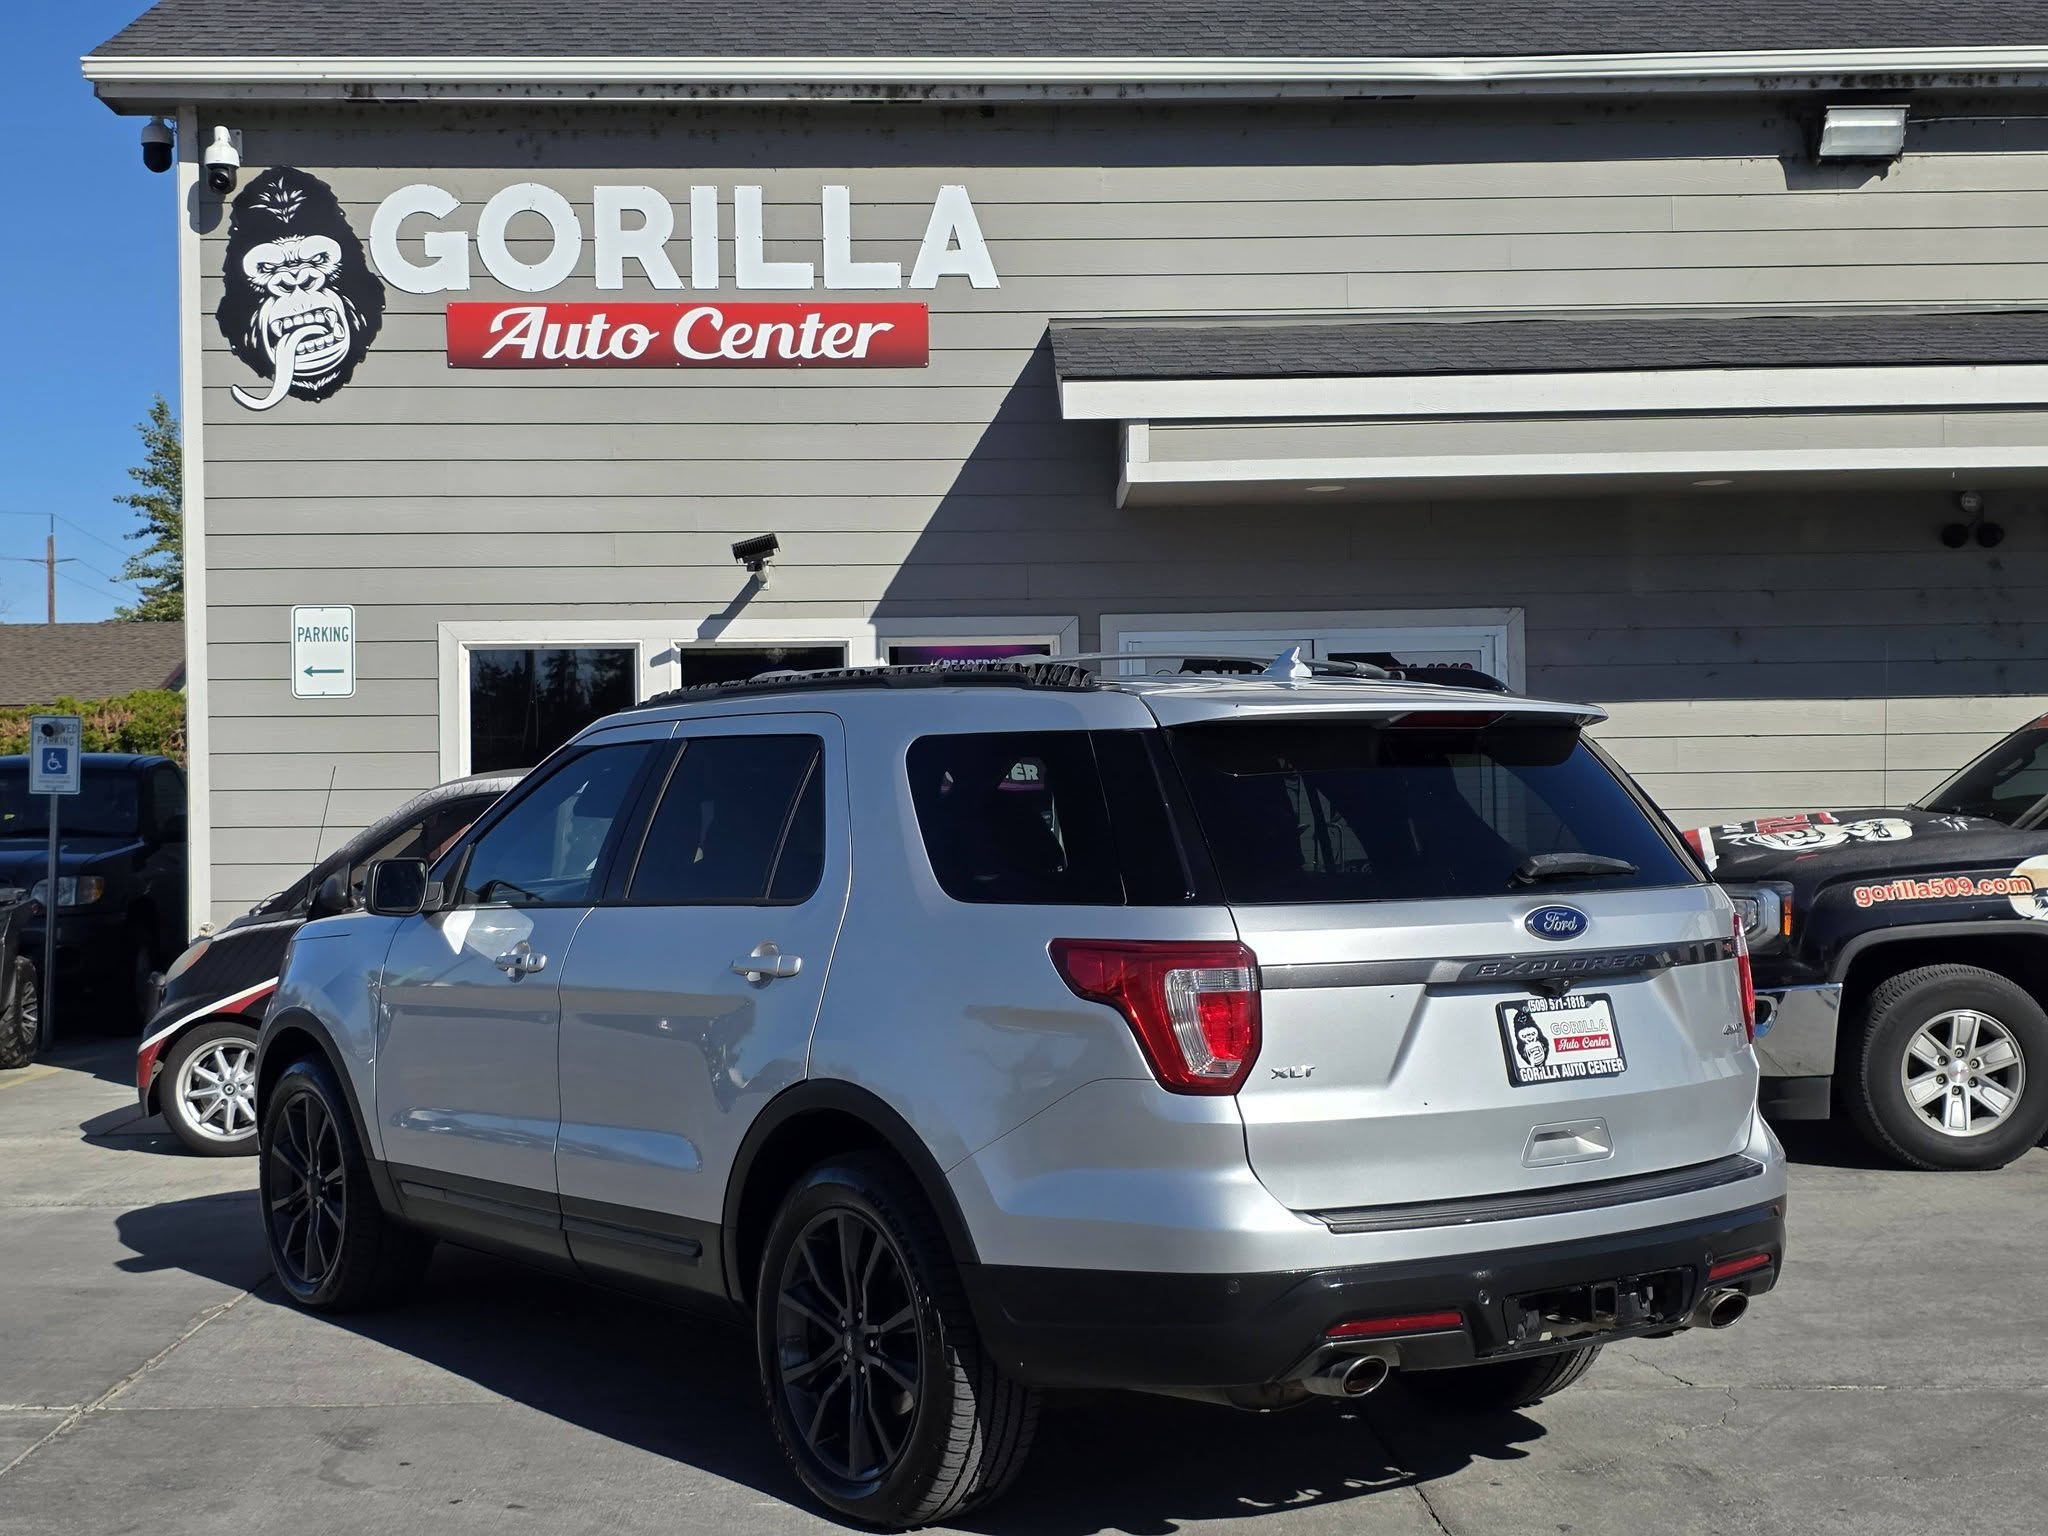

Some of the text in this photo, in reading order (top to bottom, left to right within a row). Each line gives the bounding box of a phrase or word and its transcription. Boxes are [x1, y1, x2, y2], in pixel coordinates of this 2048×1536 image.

[369, 182, 1000, 294] GORILLA
[482, 306, 896, 360] Auto Center
[297, 626, 349, 643] PARKING
[37, 735, 74, 746] PARKING
[1854, 876, 2034, 908] gorilla509.com
[1543, 911, 1578, 931] Ford
[1475, 953, 1647, 977] EXPLORER
[1527, 998, 1548, 1012] (509)
[1550, 1019, 1609, 1035] GORILLA
[1558, 1036, 1610, 1051] Auto Center
[1271, 1065, 1316, 1079] XLT
[1519, 1058, 1625, 1082] GORILLA AUTO CENTER
